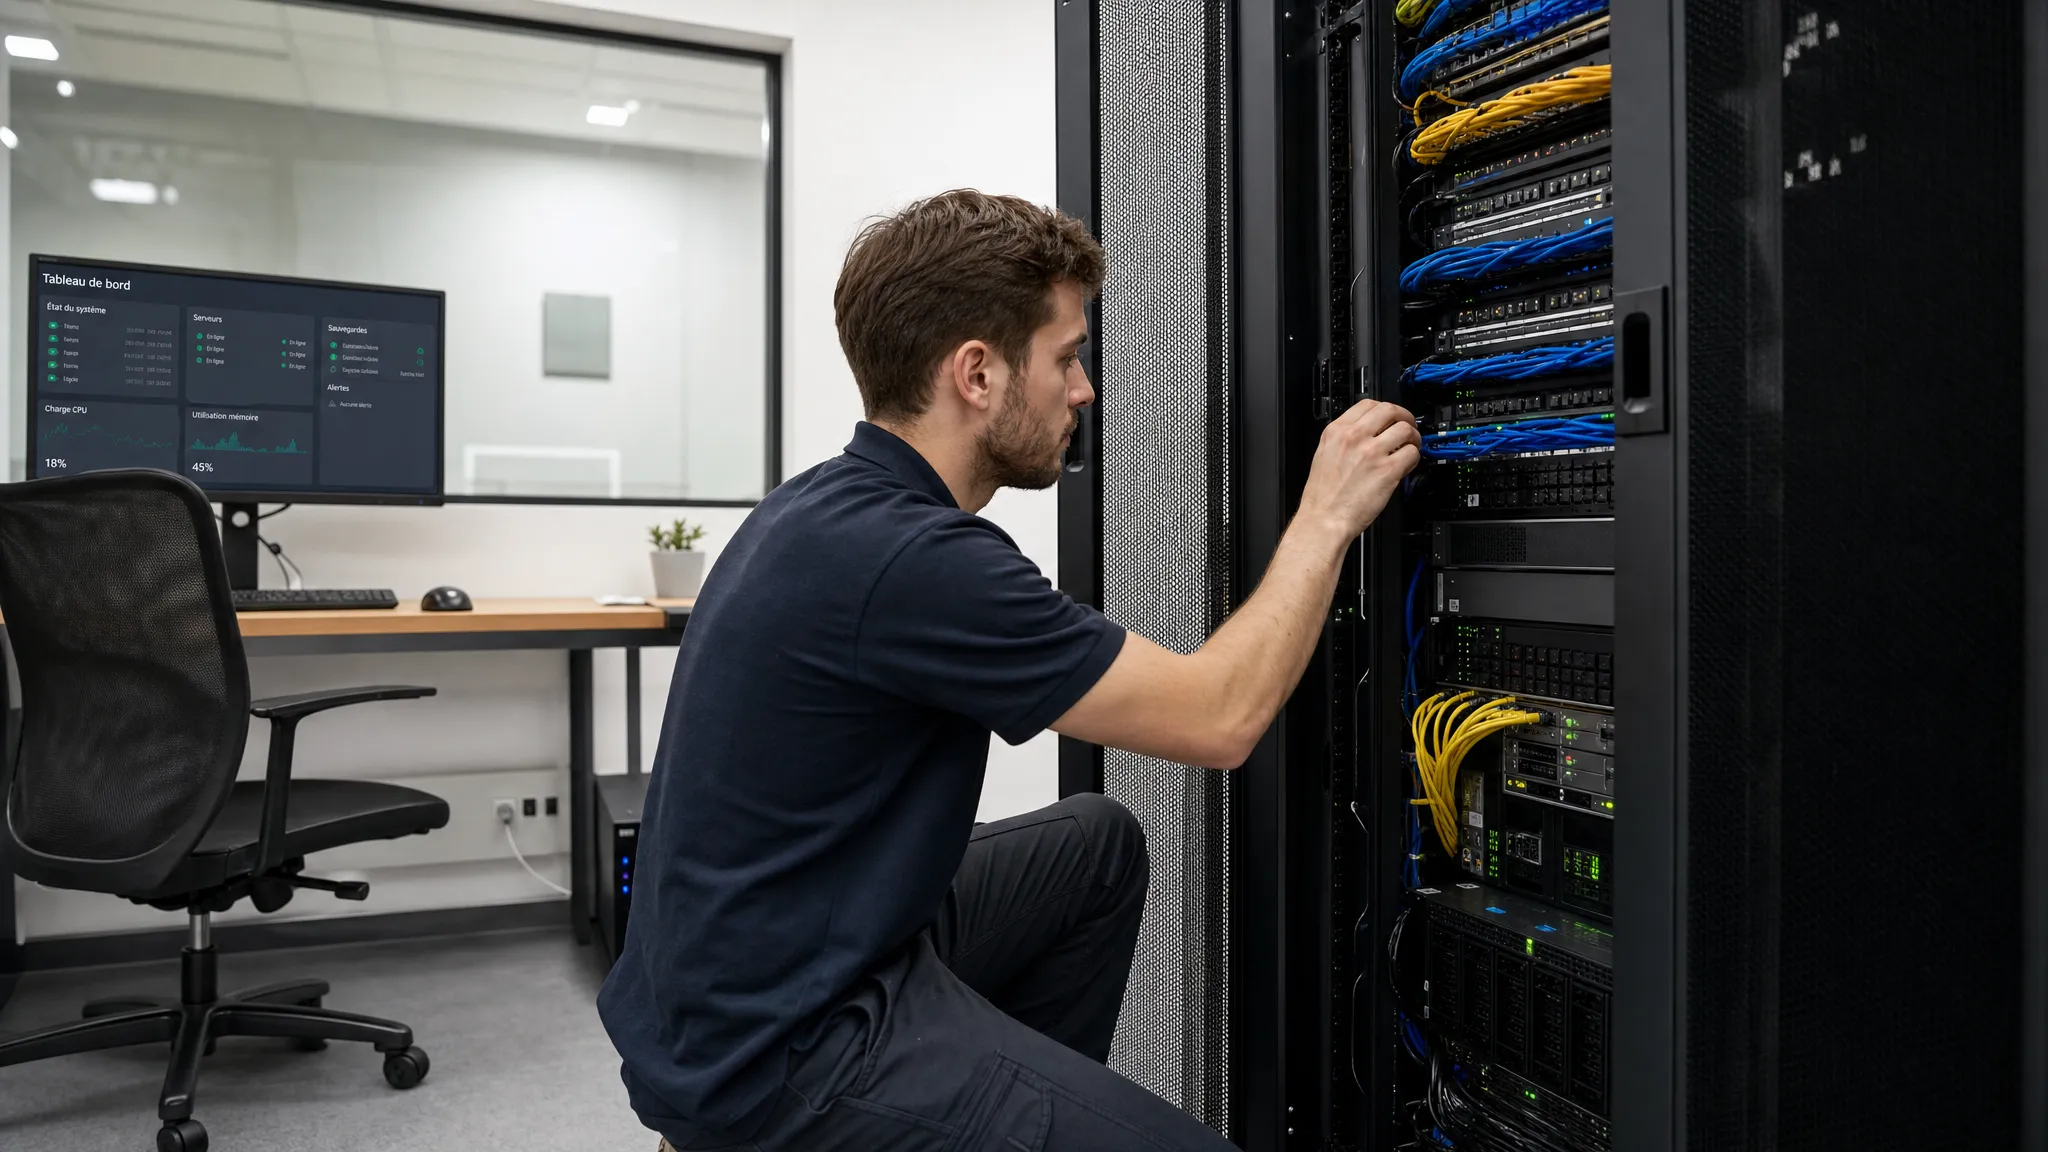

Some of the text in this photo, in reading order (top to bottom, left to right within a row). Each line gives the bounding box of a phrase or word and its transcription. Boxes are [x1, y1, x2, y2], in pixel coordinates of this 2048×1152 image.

[43, 273, 131, 291] Tableau de bord
[46, 302, 62, 311] État
[64, 304, 75, 312] du
[193, 313, 223, 323] Serveurs
[328, 324, 368, 334] Sauvegardes
[327, 384, 350, 392] Alertes
[44, 404, 88, 415] Charge CPU
[192, 411, 259, 422] Utilisation mémoire
[45, 458, 67, 469] 18%
[192, 462, 214, 472] 45%
